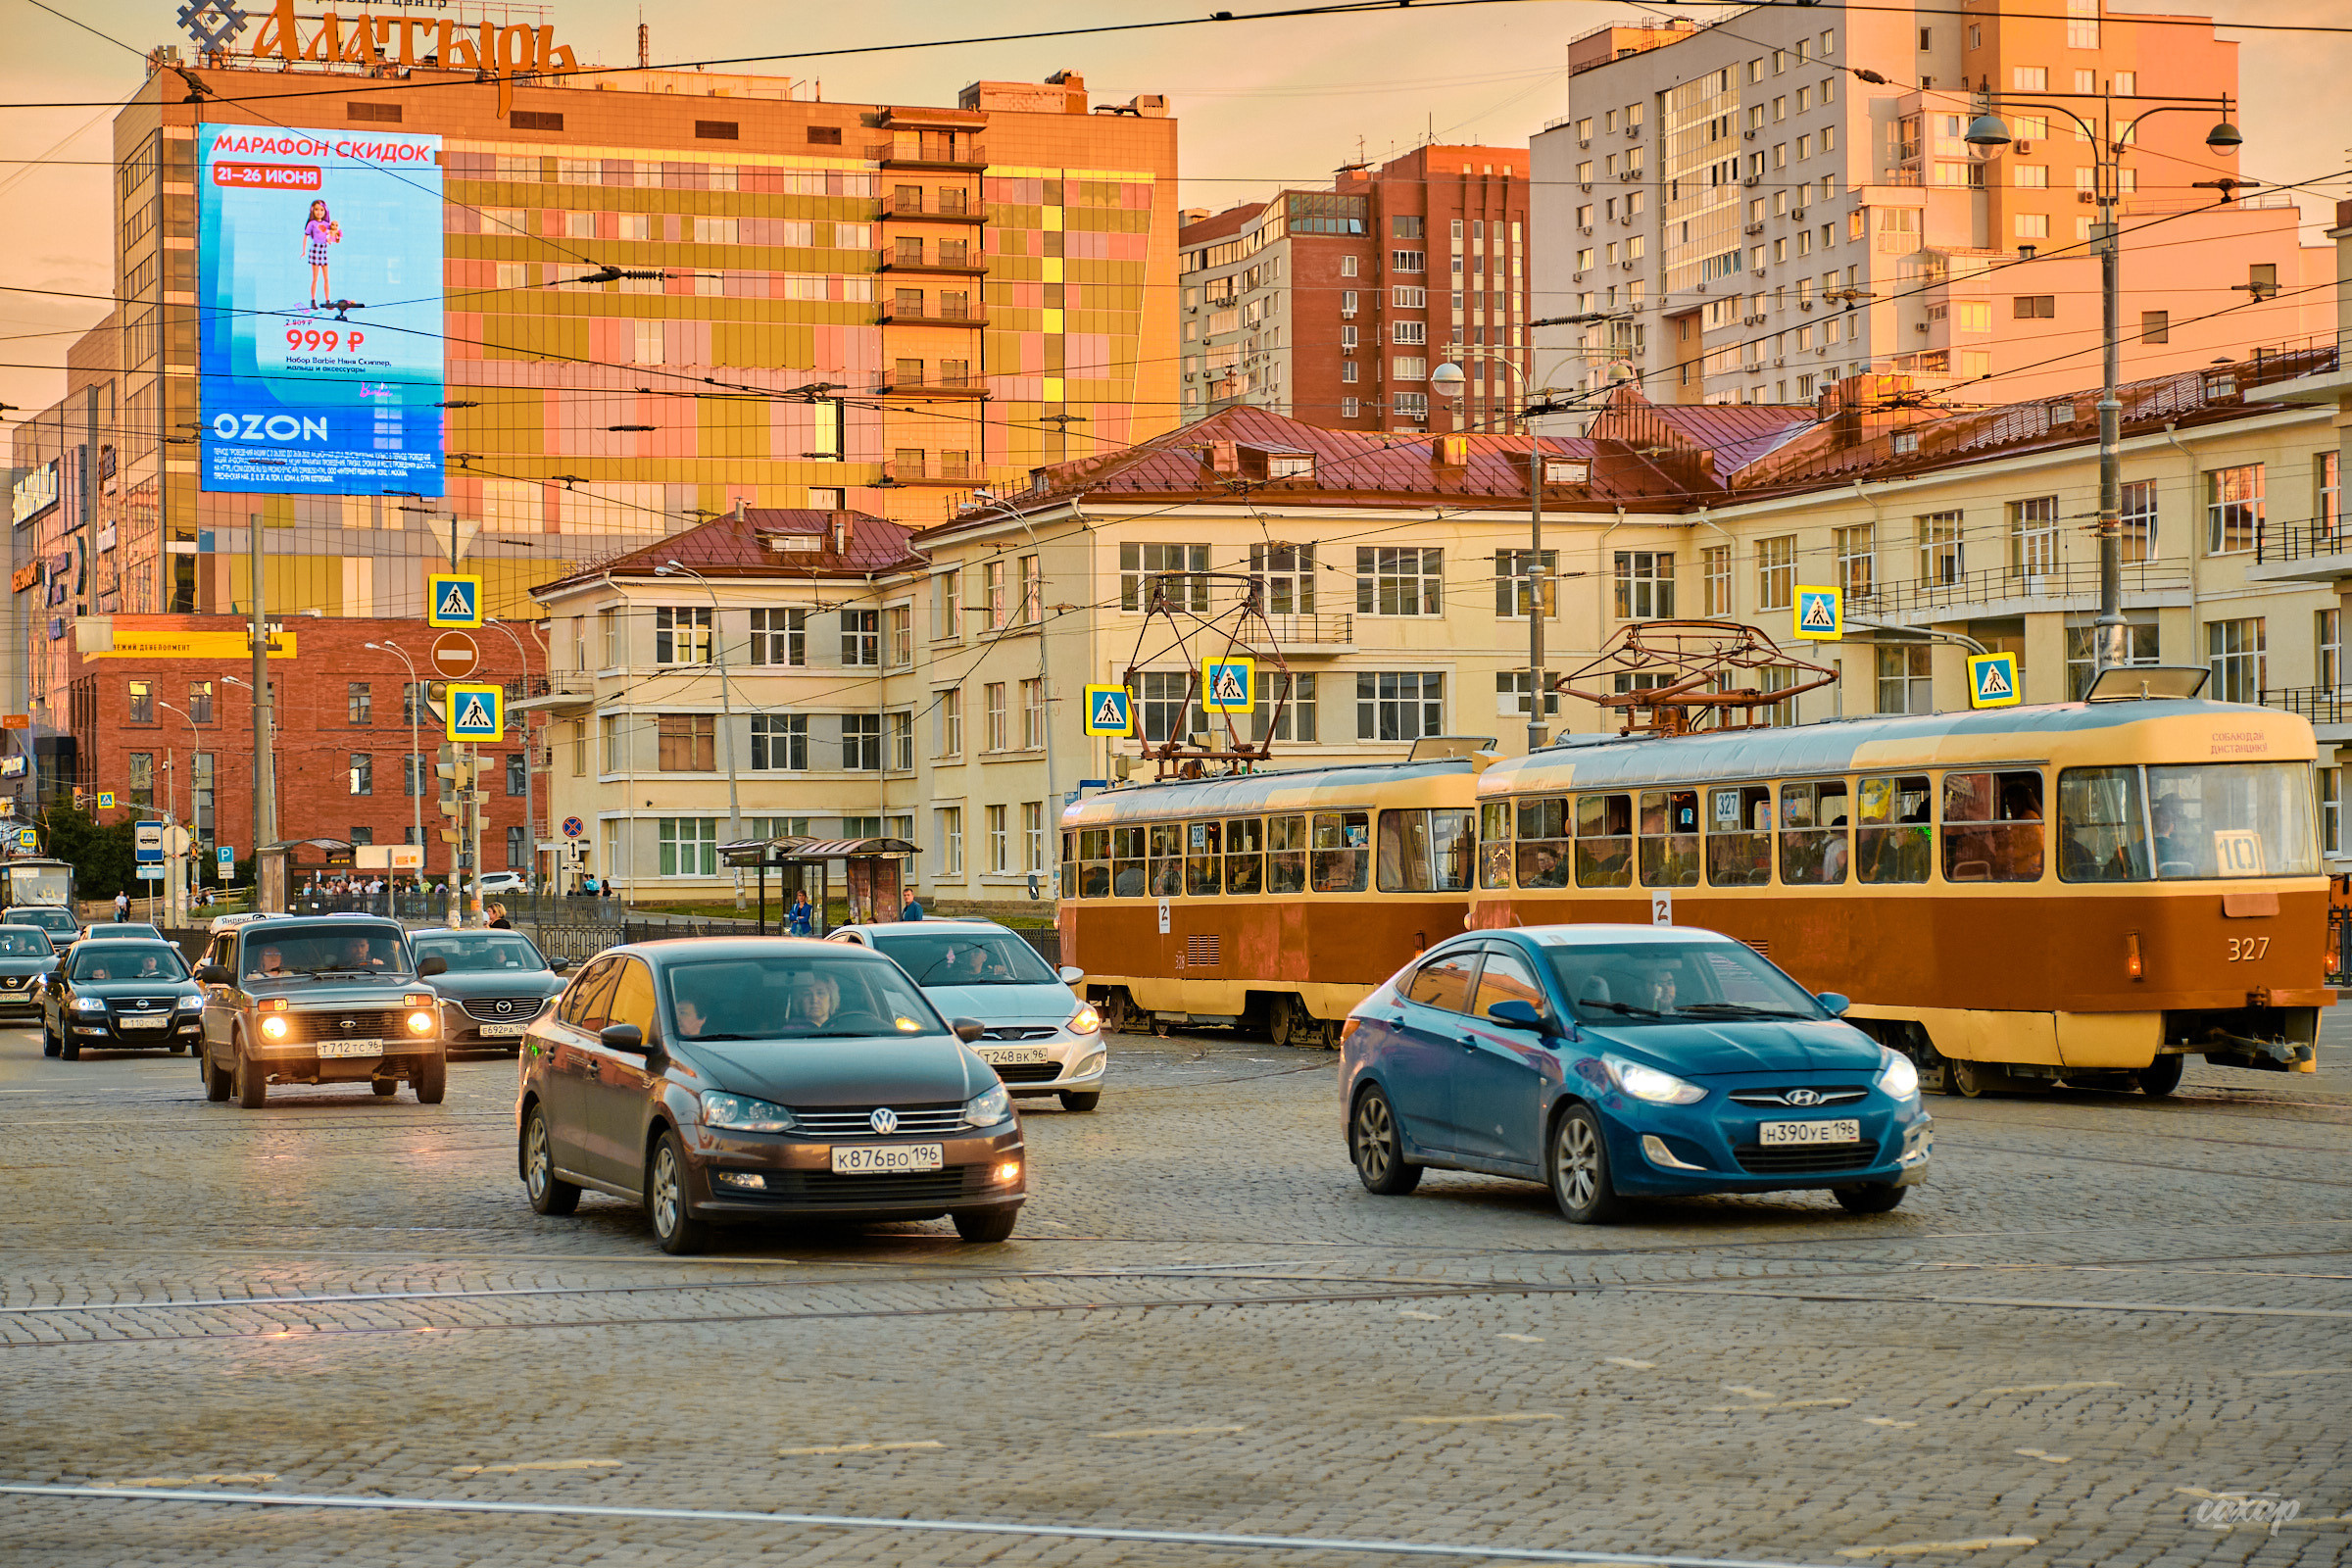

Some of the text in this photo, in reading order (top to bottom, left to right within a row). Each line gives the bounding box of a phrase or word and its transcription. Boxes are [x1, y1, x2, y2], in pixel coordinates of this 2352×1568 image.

[253, 0, 577, 119] Алатырь
[213, 134, 430, 163] МАРАФОН СКИДОК
[265, 170, 318, 184] ИЮНЯ
[286, 329, 339, 352] 999
[214, 414, 327, 441] OZON
[1719, 795, 1737, 814] 327
[1194, 827, 1203, 843] 328
[2220, 838, 2256, 869] 10
[1160, 906, 1168, 921] 2
[1656, 901, 1668, 921] 2
[2229, 937, 2271, 961] 327
[321, 1042, 366, 1054] Т712ТС
[984, 1050, 1044, 1063] Т248ВК 96
[1767, 1121, 1855, 1142] Н390УЕ 196
[838, 1147, 938, 1169] К876ВО 196
